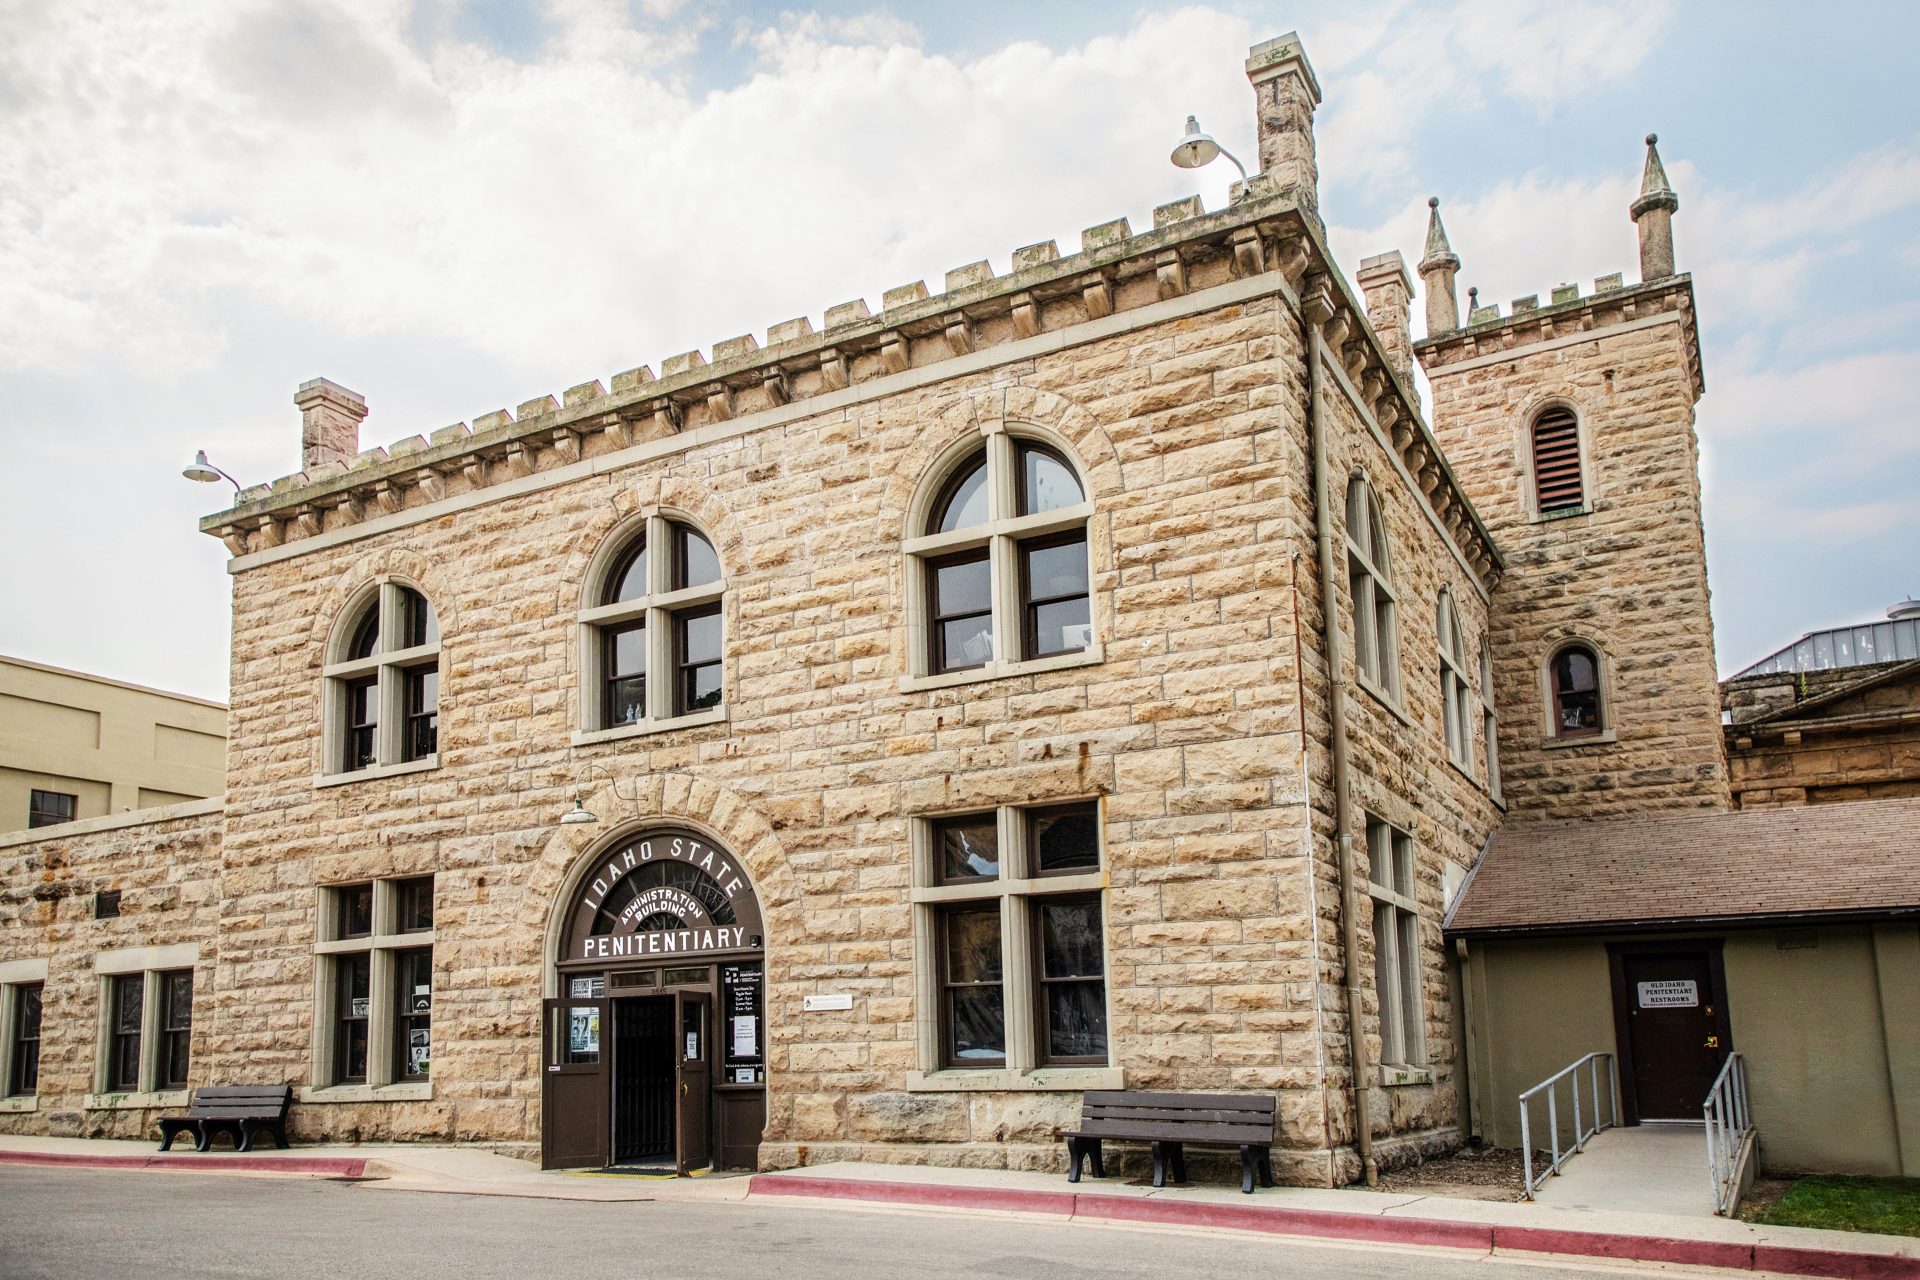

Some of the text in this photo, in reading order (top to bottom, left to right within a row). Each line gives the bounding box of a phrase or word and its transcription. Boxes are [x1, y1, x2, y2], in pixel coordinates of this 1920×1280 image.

[584, 838, 743, 910] IDAHO STATE
[620, 889, 703, 925] ADMINISTRATION
[634, 900, 686, 922] BUILDING
[584, 927, 745, 957] PENITENTIARY
